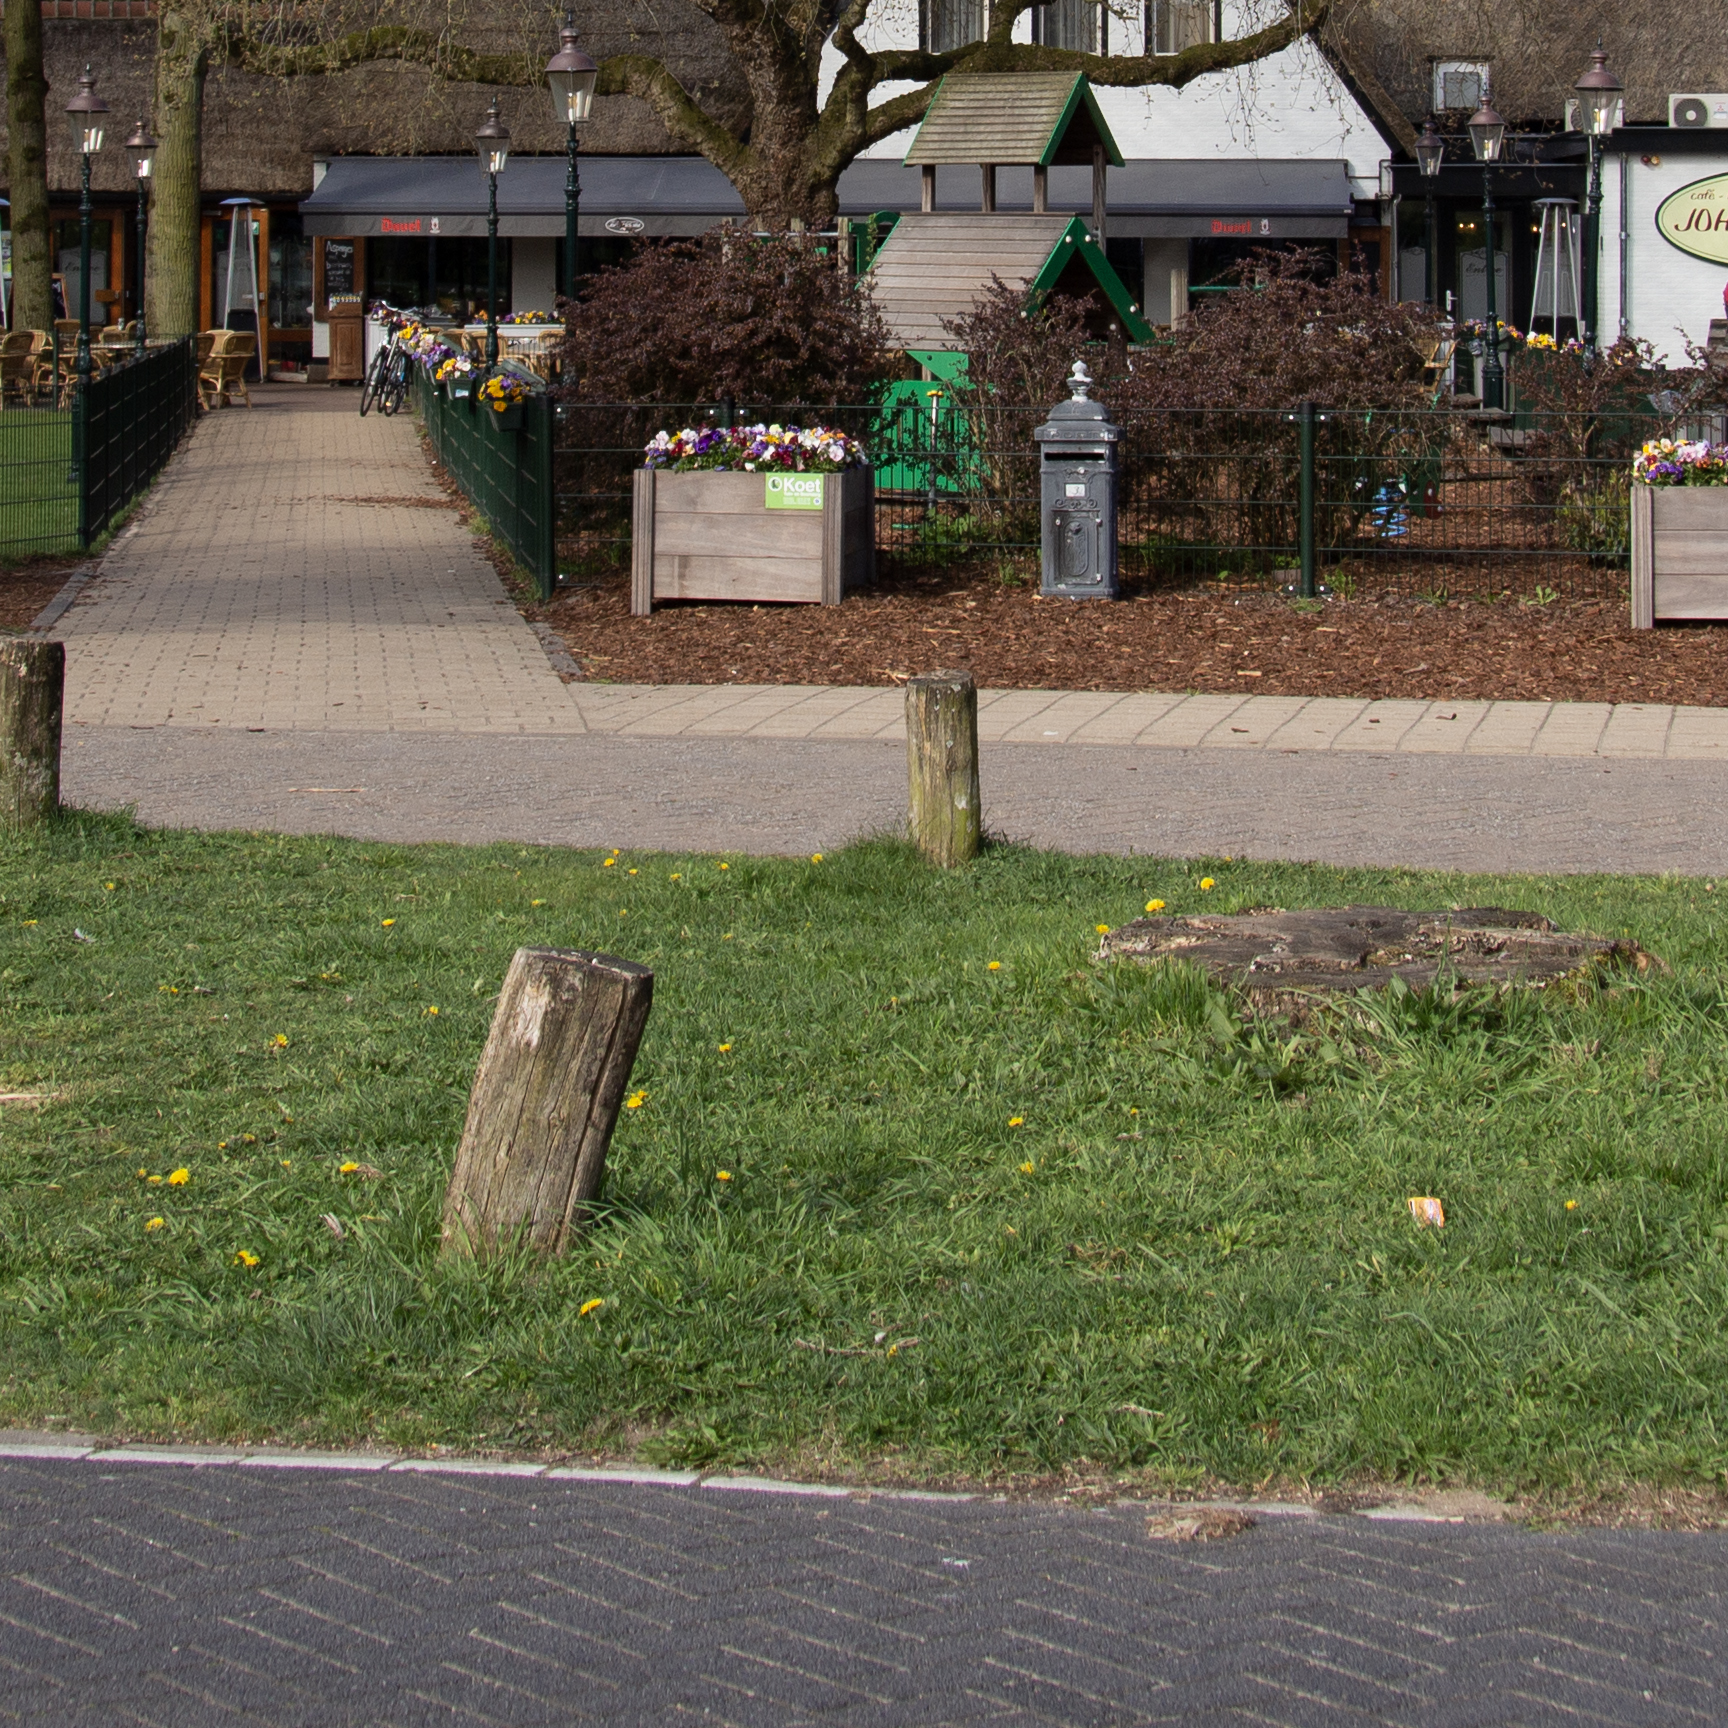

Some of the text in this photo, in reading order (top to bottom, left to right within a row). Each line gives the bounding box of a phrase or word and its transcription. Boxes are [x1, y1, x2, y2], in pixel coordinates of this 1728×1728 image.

[1690, 188, 1715, 200] café
[381, 218, 421, 232] Duvel
[1211, 219, 1252, 234] Duvel
[783, 477, 821, 493] Koet
